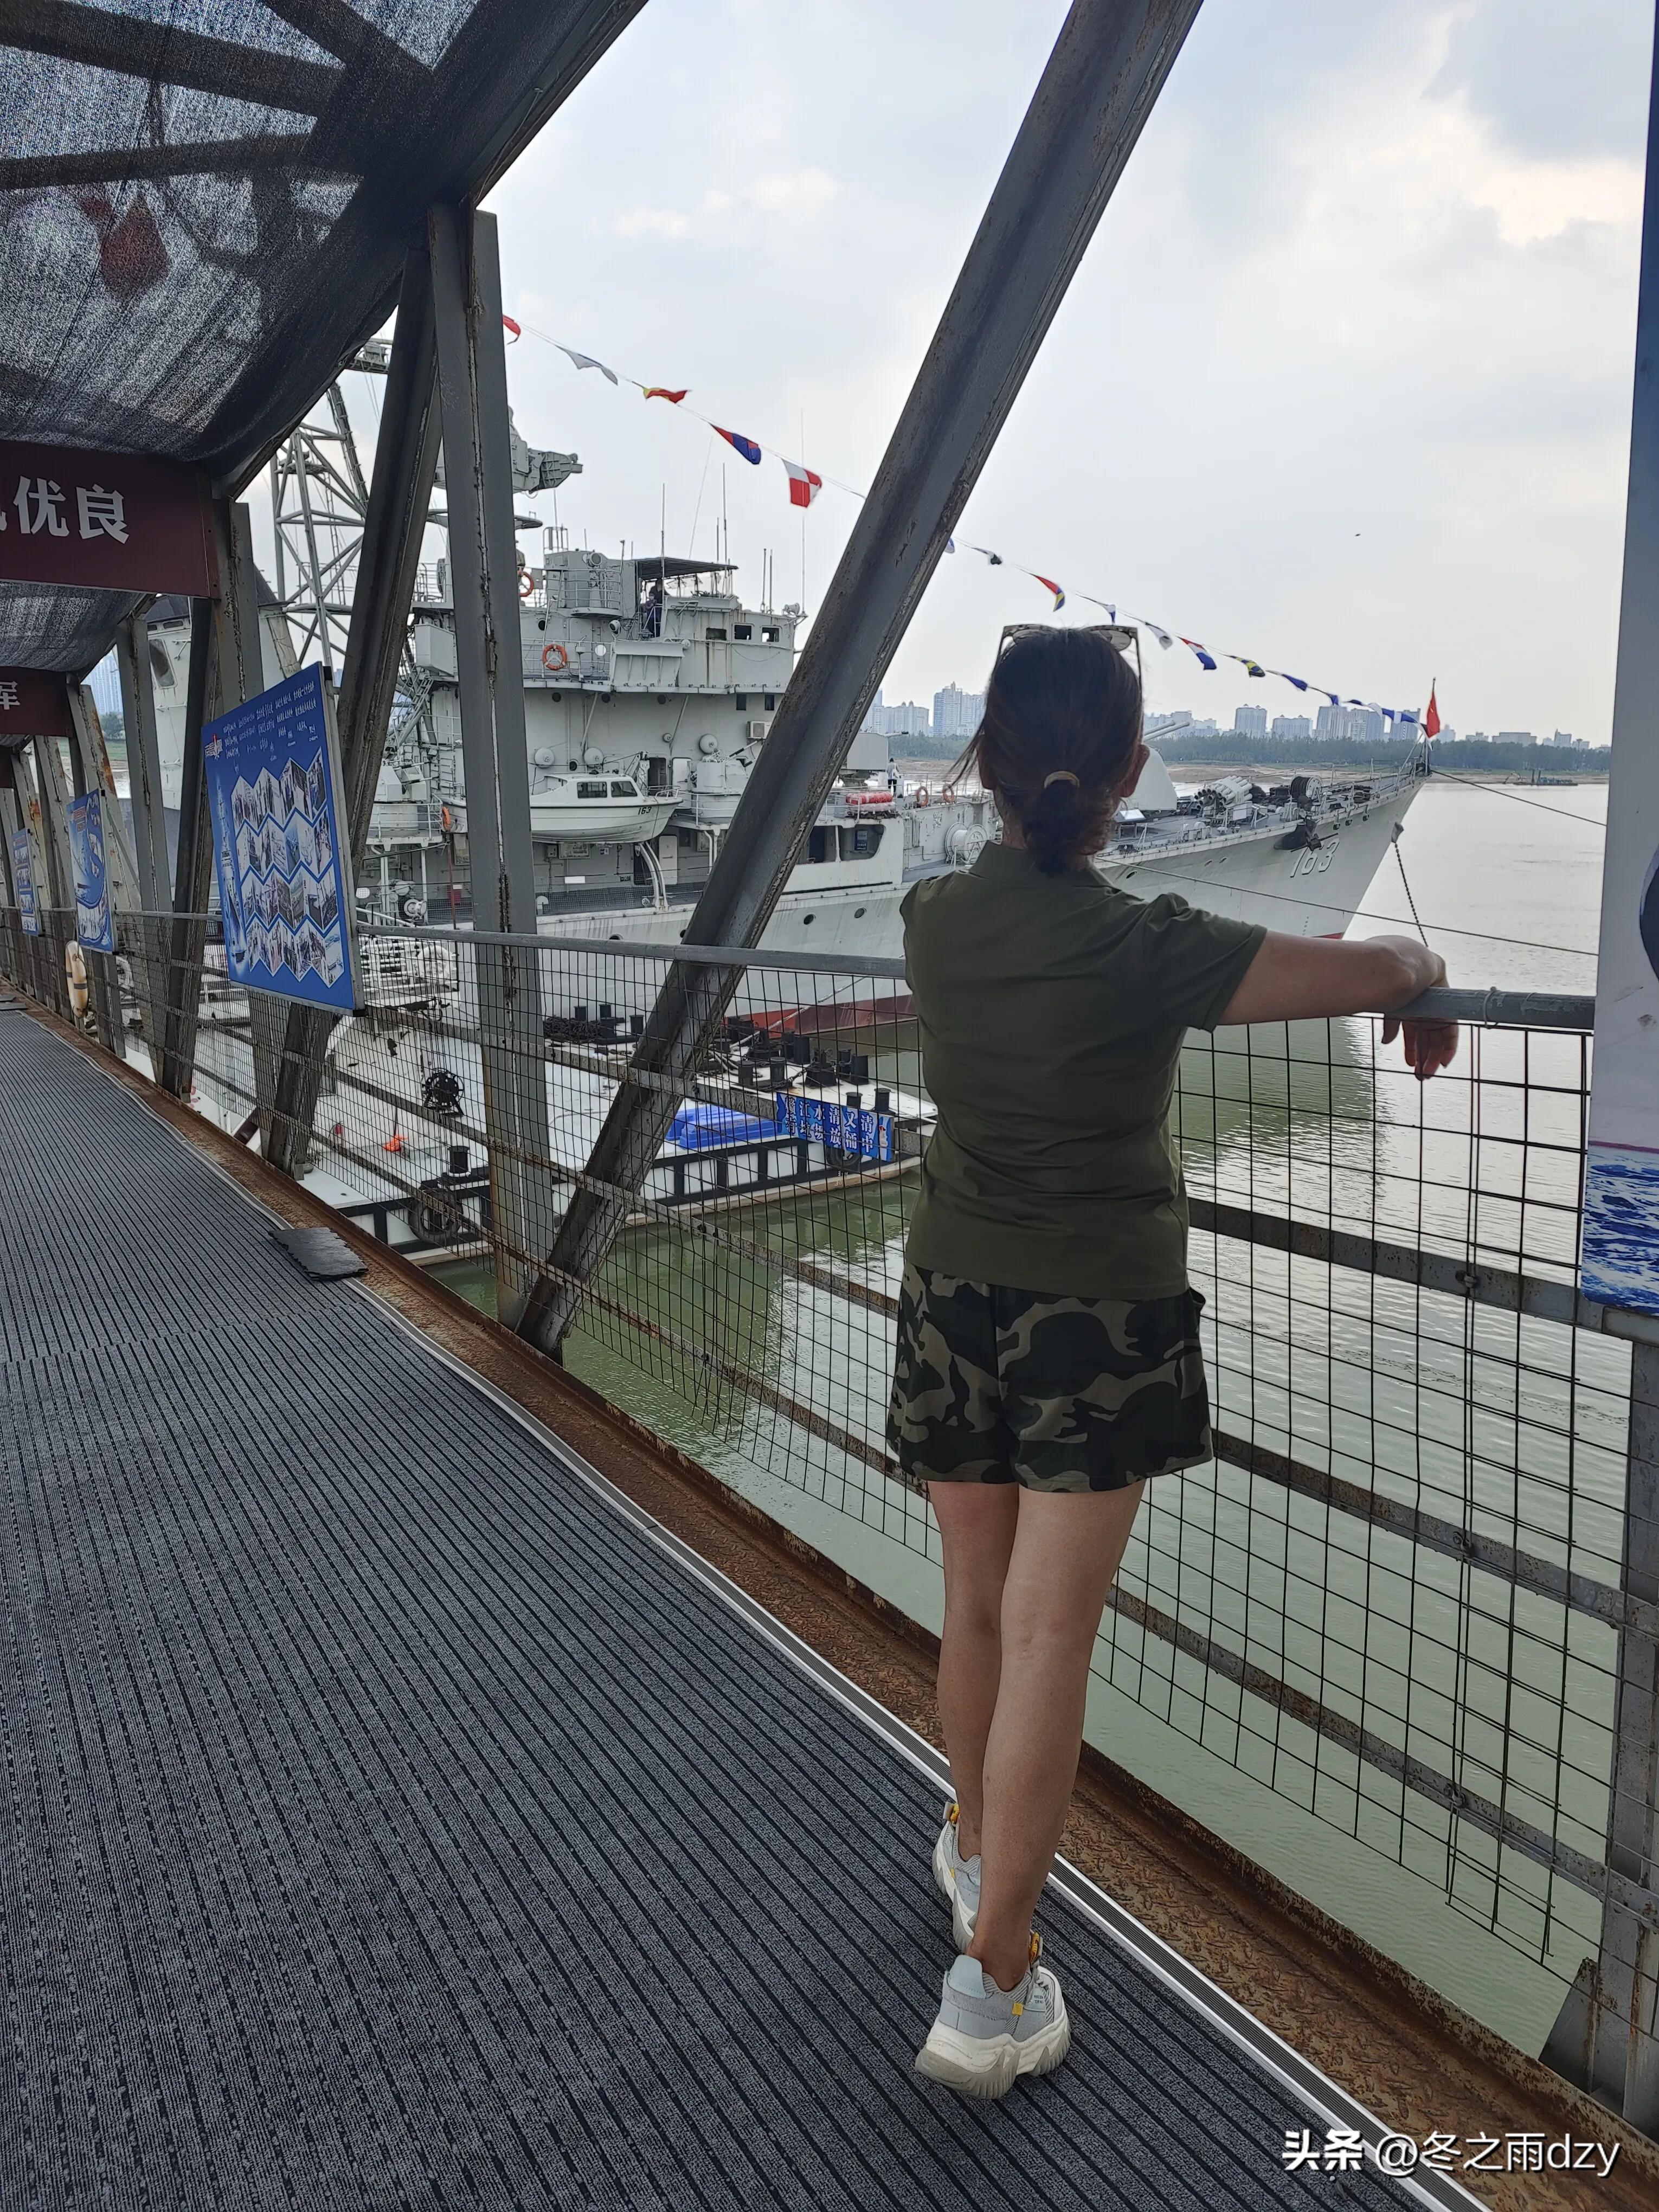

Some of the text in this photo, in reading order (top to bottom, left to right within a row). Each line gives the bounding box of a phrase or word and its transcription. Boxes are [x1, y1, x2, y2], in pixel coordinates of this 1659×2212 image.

[0, 476, 130, 544] 优良
[638, 806, 652, 815] 163
[1290, 838, 1340, 878] 163
